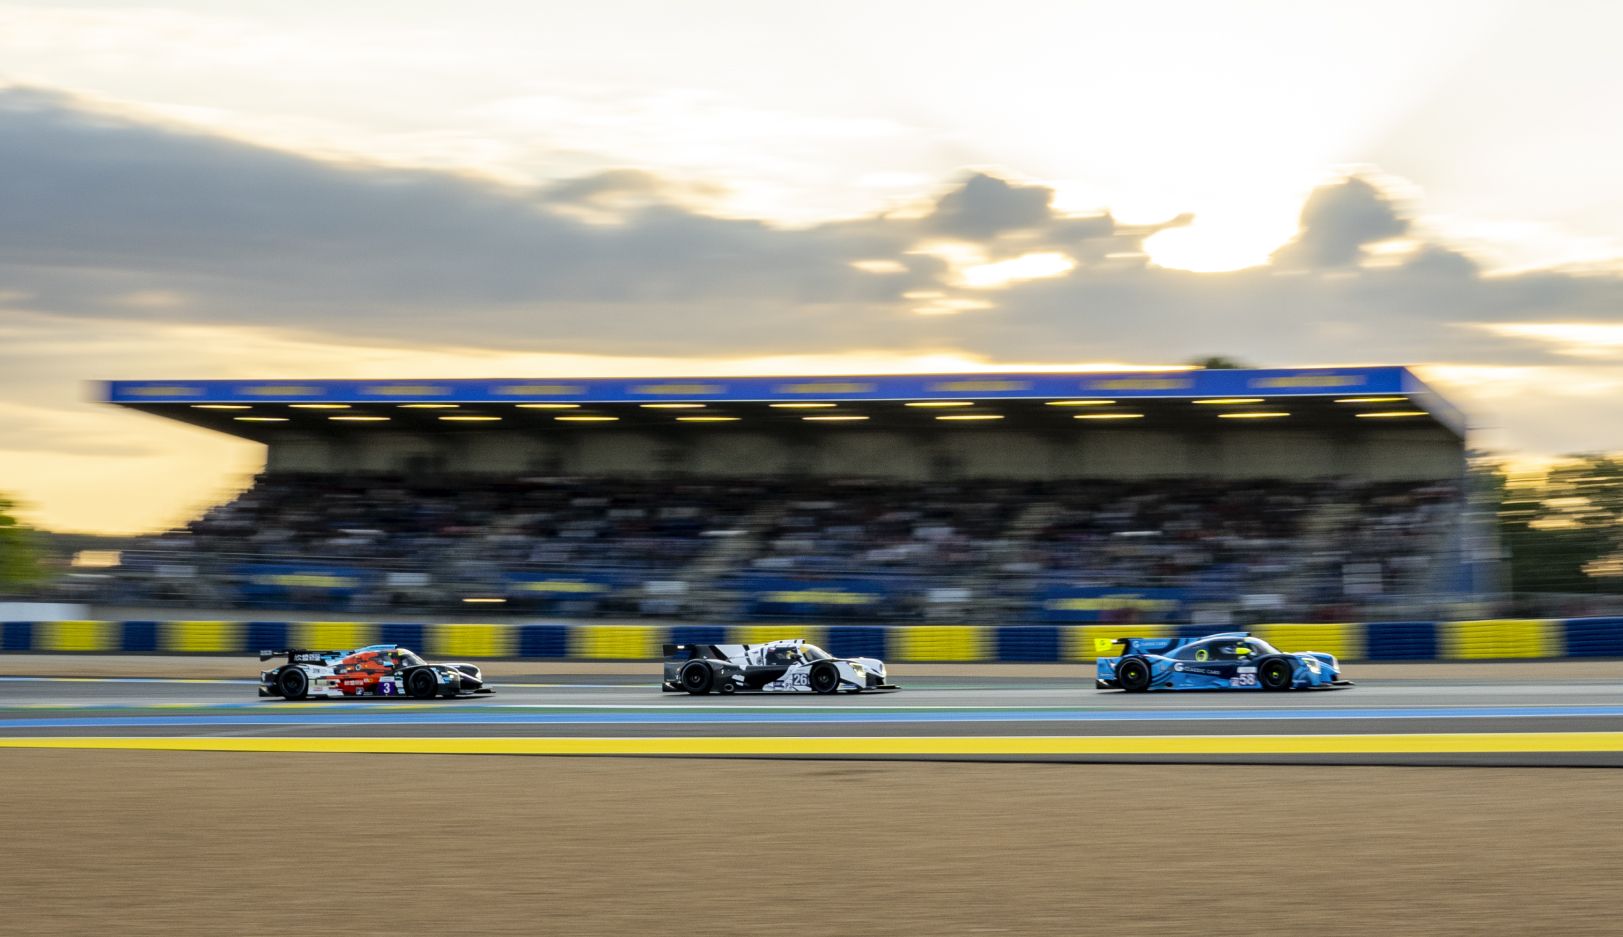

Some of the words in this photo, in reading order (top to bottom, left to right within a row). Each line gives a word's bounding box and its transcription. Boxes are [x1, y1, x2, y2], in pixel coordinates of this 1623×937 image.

[793, 673, 808, 686] 26
[1239, 673, 1256, 686] 58
[383, 682, 391, 694] 3
